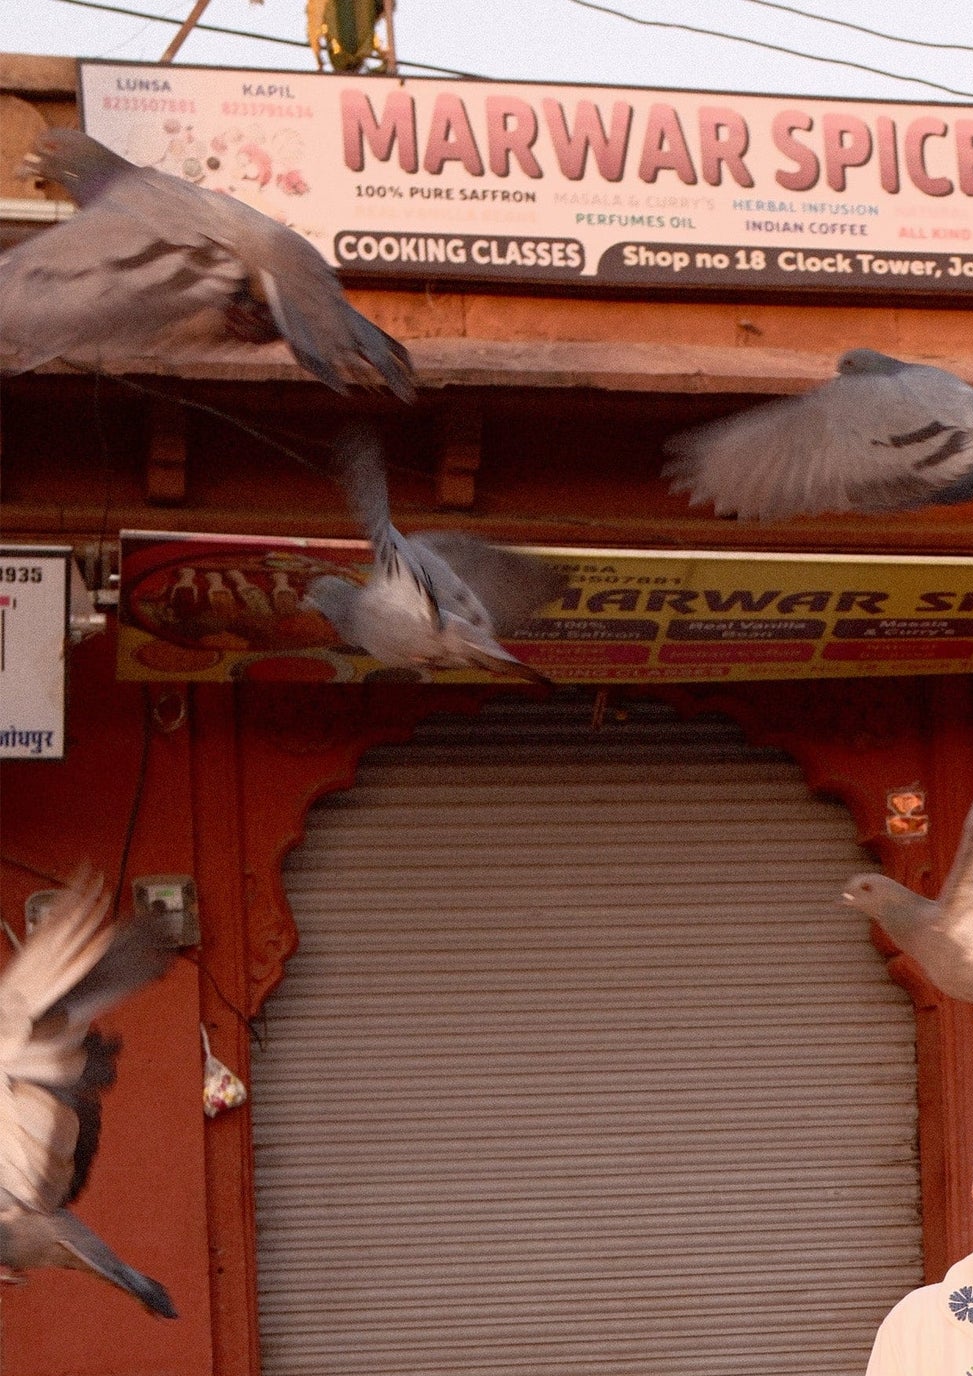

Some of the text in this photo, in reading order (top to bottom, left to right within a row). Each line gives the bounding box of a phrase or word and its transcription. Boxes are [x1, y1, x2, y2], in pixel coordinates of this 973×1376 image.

[116, 77, 172, 93] LUNSA
[241, 84, 296, 100] KAPIL
[339, 87, 755, 190] MARWAR
[354, 184, 537, 204] 100% PURE SAFFRON
[732, 199, 880, 217] HERBAL INFUSION
[574, 212, 697, 231] PERFUMES OIL
[745, 219, 868, 237] INDIAN COFFEE
[898, 226, 926, 240] ALL
[931, 227, 972, 242] KIND
[337, 235, 582, 268] COOKING CLASSES
[622, 245, 690, 273] Shop
[695, 252, 730, 270] no
[735, 250, 766, 271] 18
[777, 250, 852, 276] Clock
[857, 254, 942, 280] Tower,
[688, 621, 807, 631] Real Vanilla
[878, 619, 949, 629] Masala
